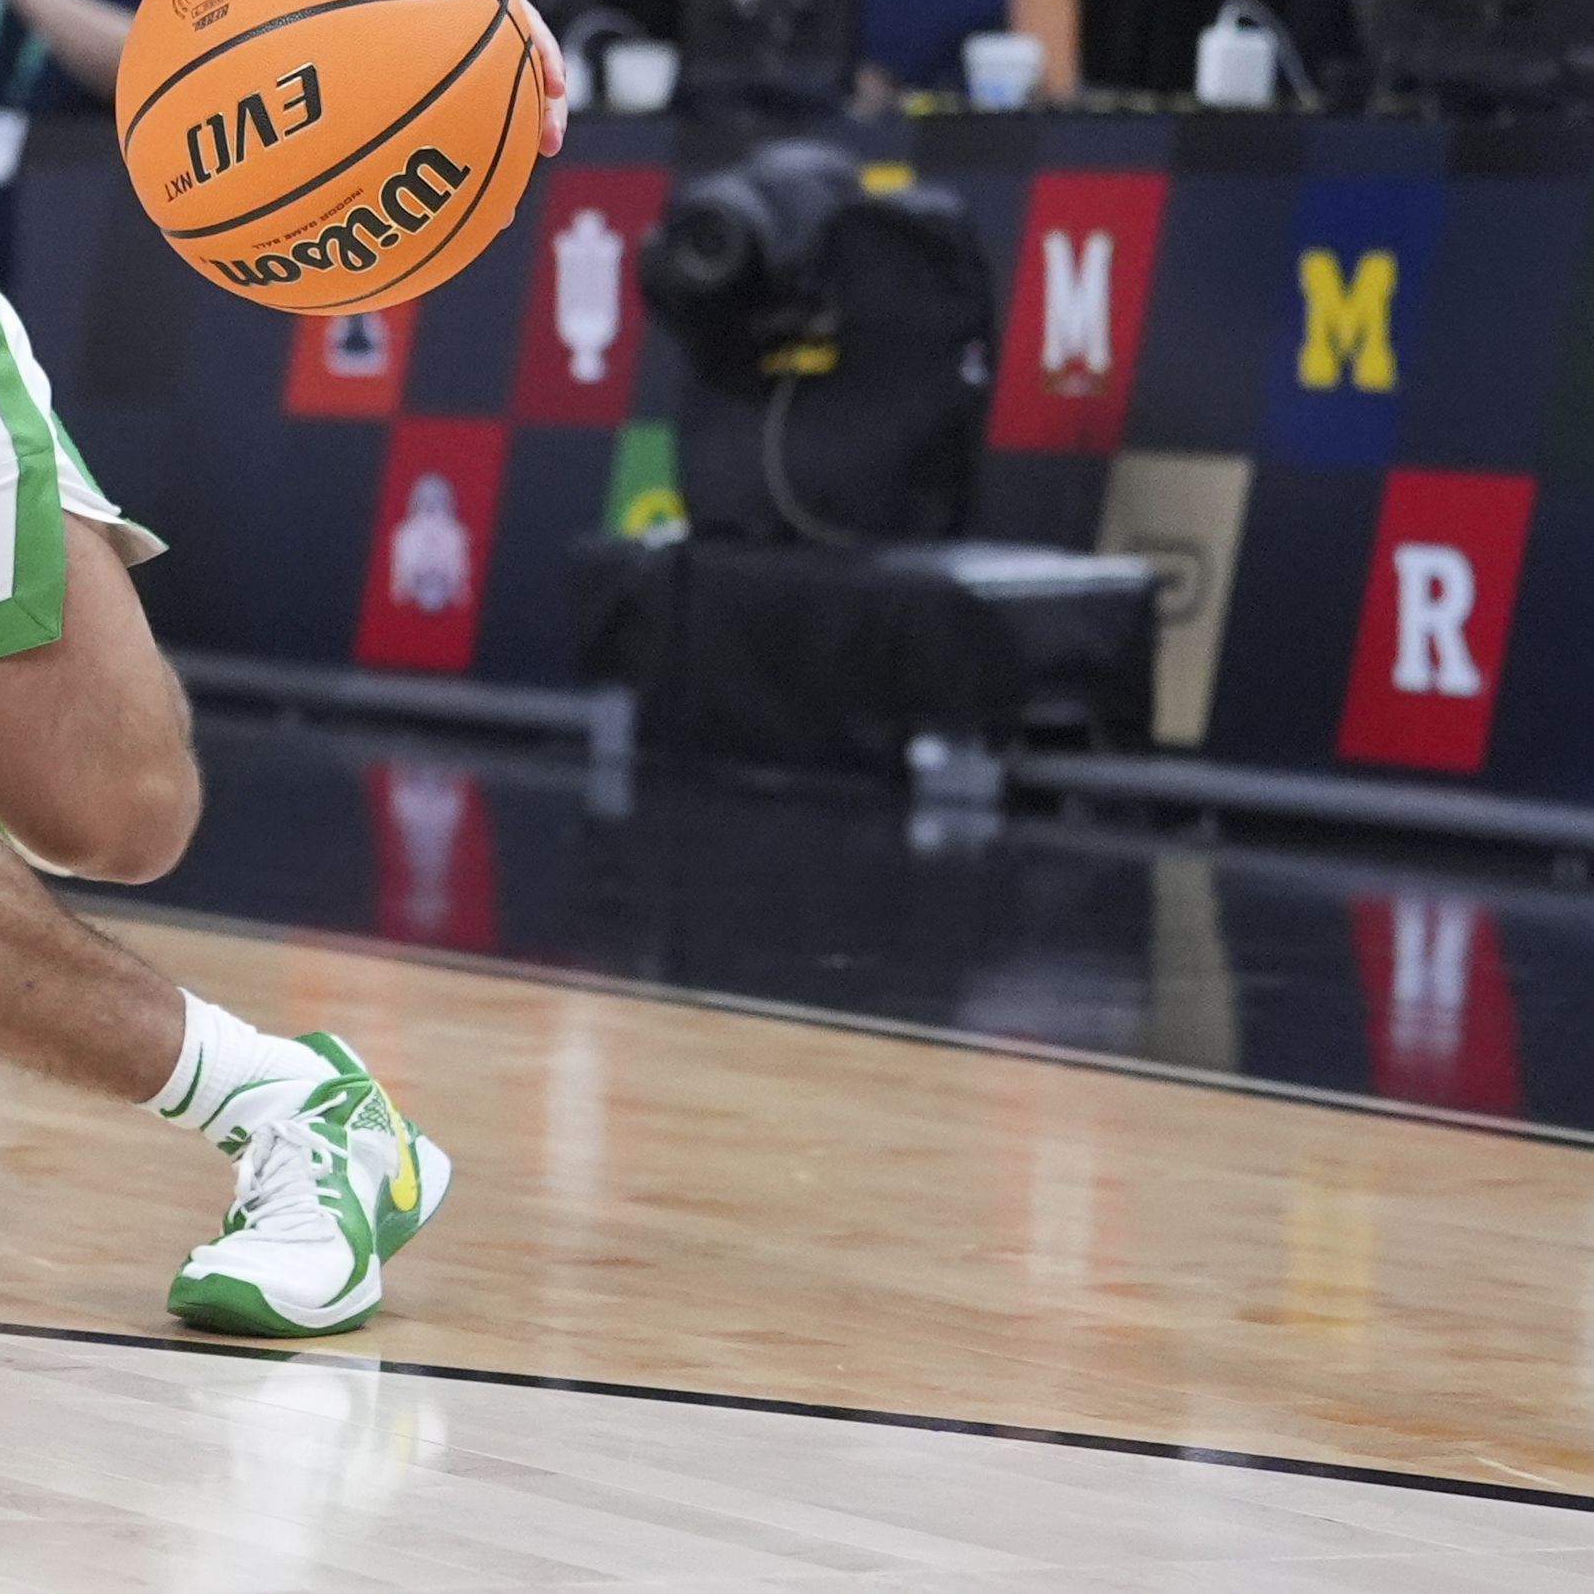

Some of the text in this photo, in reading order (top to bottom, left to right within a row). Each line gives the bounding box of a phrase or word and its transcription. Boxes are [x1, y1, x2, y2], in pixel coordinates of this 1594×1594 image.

[186, 62, 323, 185] EVO
[164, 171, 194, 203] NXT
[208, 145, 473, 287] Wilson
[252, 236, 283, 251] BALL
[319, 187, 364, 222] INDOOR
[1298, 248, 1398, 392] M
[1392, 542, 1484, 697] R
